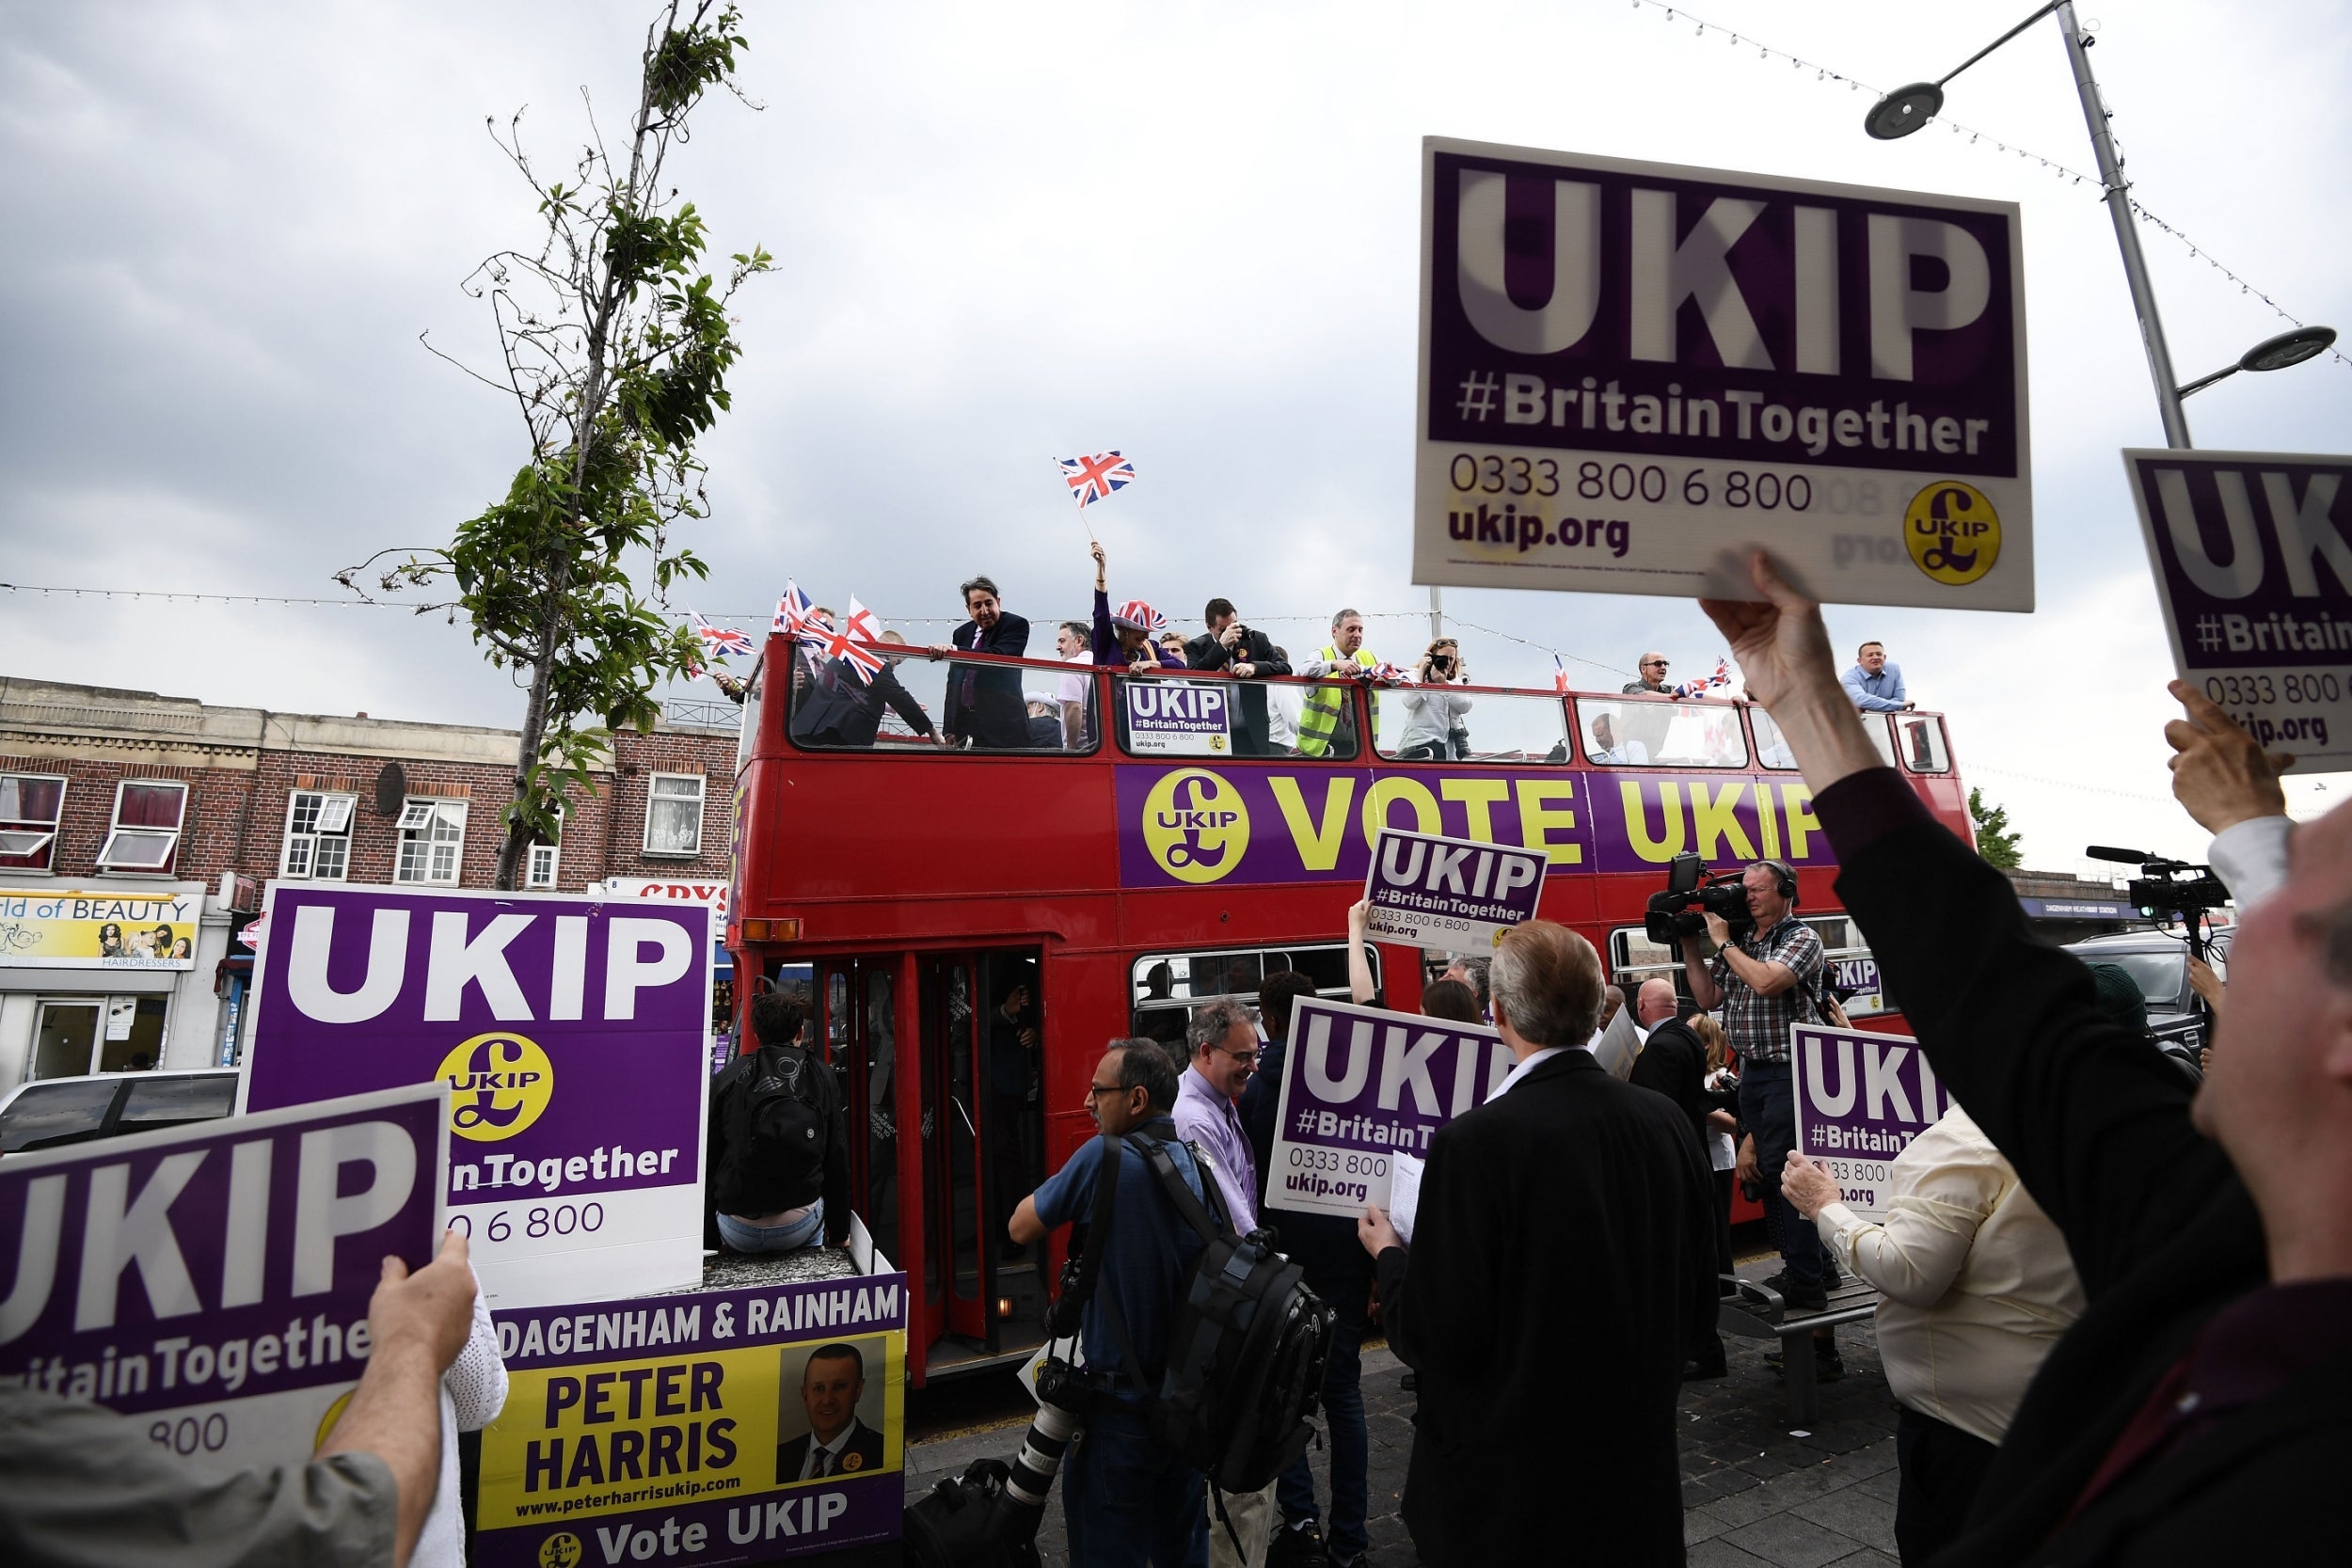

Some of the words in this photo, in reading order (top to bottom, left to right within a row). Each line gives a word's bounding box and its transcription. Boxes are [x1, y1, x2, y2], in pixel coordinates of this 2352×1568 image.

[1457, 167, 1991, 382] UKIP
[1456, 370, 1989, 457] #BritainTogether
[1450, 453, 1561, 498] 0333
[1578, 461, 1667, 505] 800
[1682, 468, 1709, 508] 6
[1725, 469, 1812, 513] 800
[1448, 504, 1629, 557] ukip.org
[1915, 518, 1990, 538] UKIP
[1132, 687, 1222, 719] UKIP
[2206, 675, 2277, 705] 0333
[2283, 673, 2341, 704] 800
[1136, 719, 1223, 732] #BritainTogether
[1136, 732, 1154, 740] 0333
[1157, 811, 1238, 829] UKIP
[1267, 776, 1581, 871] VOTE
[1618, 780, 1822, 865] UKIP
[1381, 837, 1537, 900] UKIP
[37, 899, 66, 919] of
[72, 900, 189, 922] BEAUTY
[1371, 908, 1402, 923] 0333
[1405, 912, 1430, 927] 800
[1433, 915, 1441, 927] 6
[1444, 918, 1470, 932] 800
[1375, 888, 1525, 922] #BritainTogether
[1368, 921, 1418, 939] ukip.org
[103, 958, 181, 968] HAIRDRESSERS
[287, 905, 692, 1024] UKIP
[448, 1072, 541, 1091] UKIP
[1804, 1037, 1958, 1125] UKI
[1295, 1108, 1435, 1149] #BritainT
[1811, 1124, 1915, 1153] #BritainT
[449, 1145, 678, 1192] nTogether
[1289, 1148, 1339, 1171] 0333
[1346, 1155, 1387, 1178] 800
[1854, 1164, 1885, 1182] 800
[1285, 1172, 1368, 1202] ukip.org
[487, 1211, 512, 1242] 6
[526, 1202, 604, 1238] 800
[498, 1305, 701, 1358] DAGENHAM
[711, 1302, 736, 1339] &
[747, 1284, 899, 1335] RAINHAM
[544, 1361, 724, 1430] PETER
[524, 1418, 738, 1494] HARRIS
[516, 1476, 740, 1517] www.peterharrisukip.com
[596, 1516, 707, 1566] Vote
[727, 1492, 848, 1544] UKIP
[544, 1545, 577, 1557] UKIP
